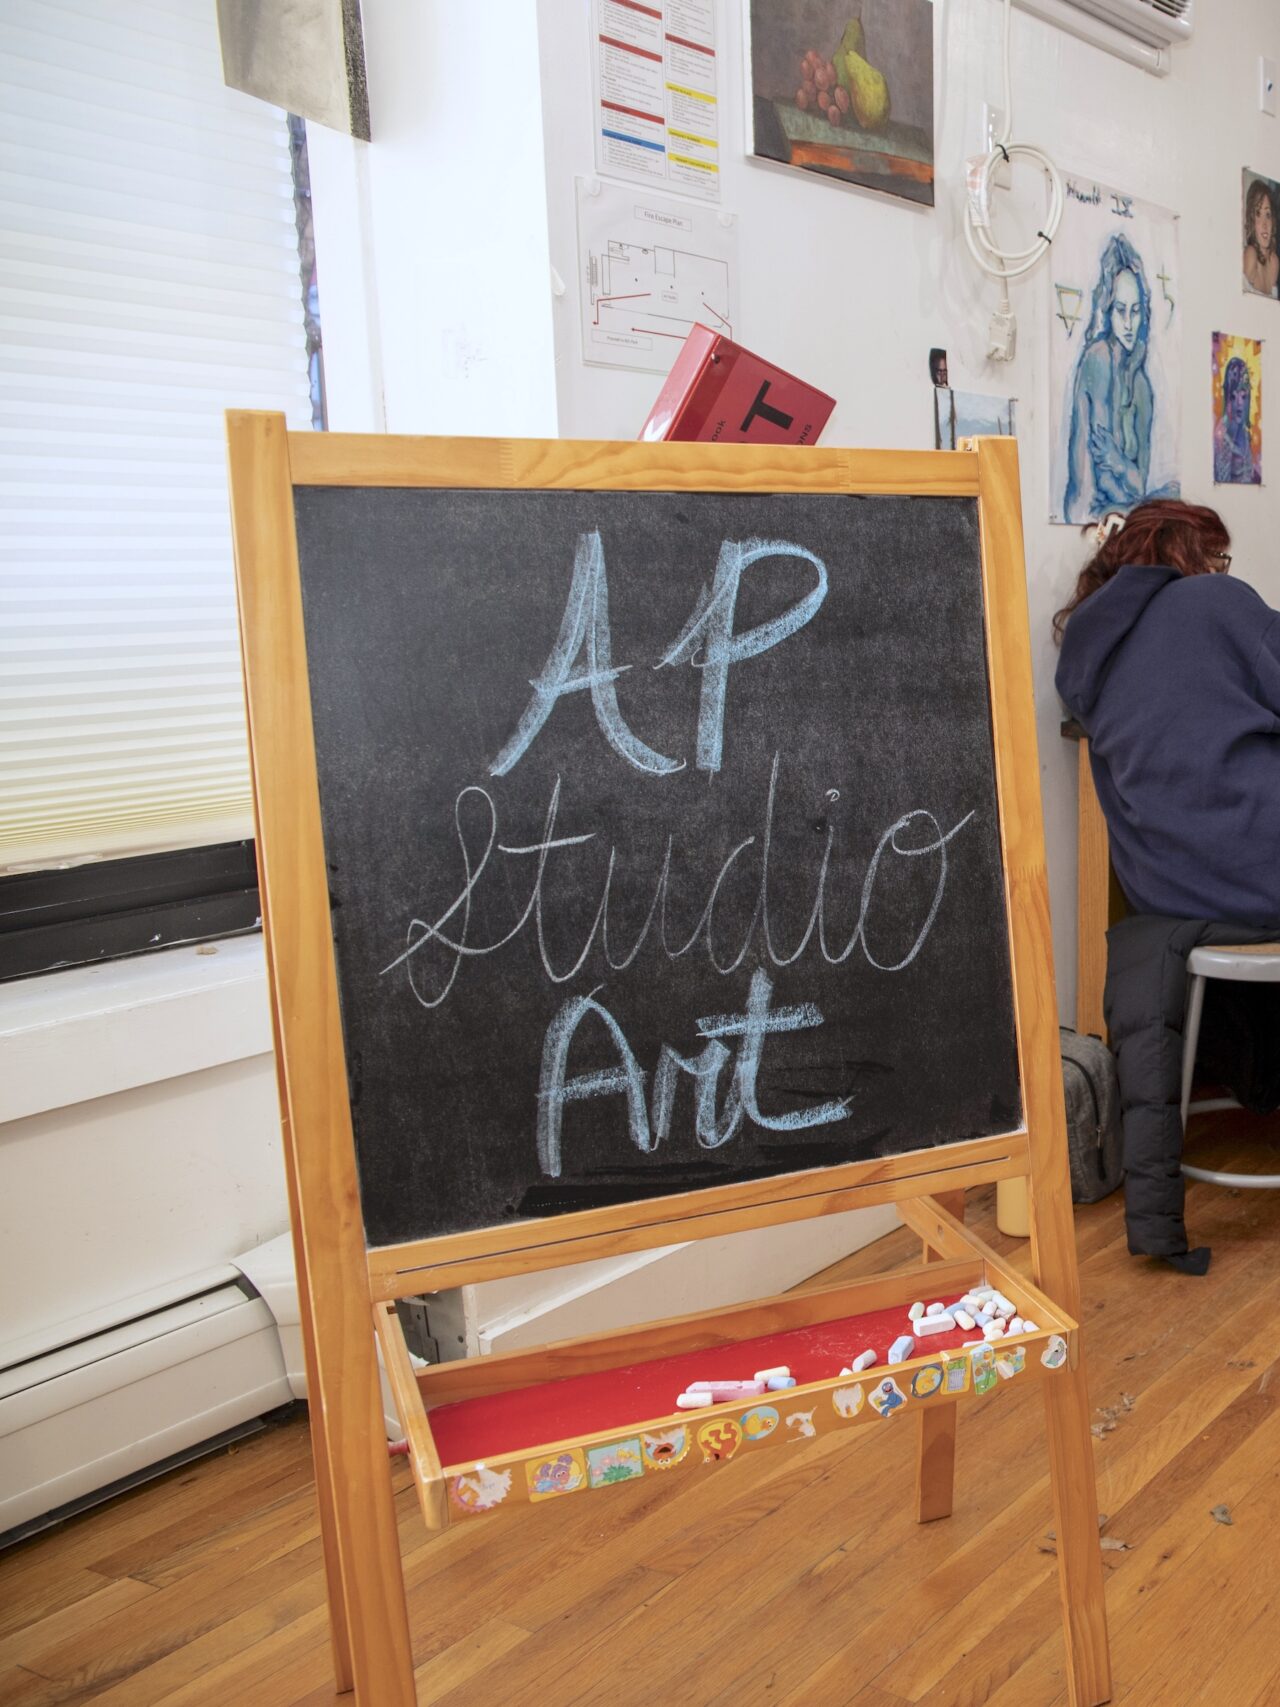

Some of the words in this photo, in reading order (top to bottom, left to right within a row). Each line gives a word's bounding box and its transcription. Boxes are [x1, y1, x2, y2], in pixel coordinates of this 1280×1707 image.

[644, 211, 655, 220] Fire
[655, 213, 672, 224] Escape
[672, 218, 683, 226] Plan
[711, 420, 726, 442] ook
[740, 380, 795, 432] T
[489, 527, 829, 784] AP
[535, 968, 855, 1178] Art
